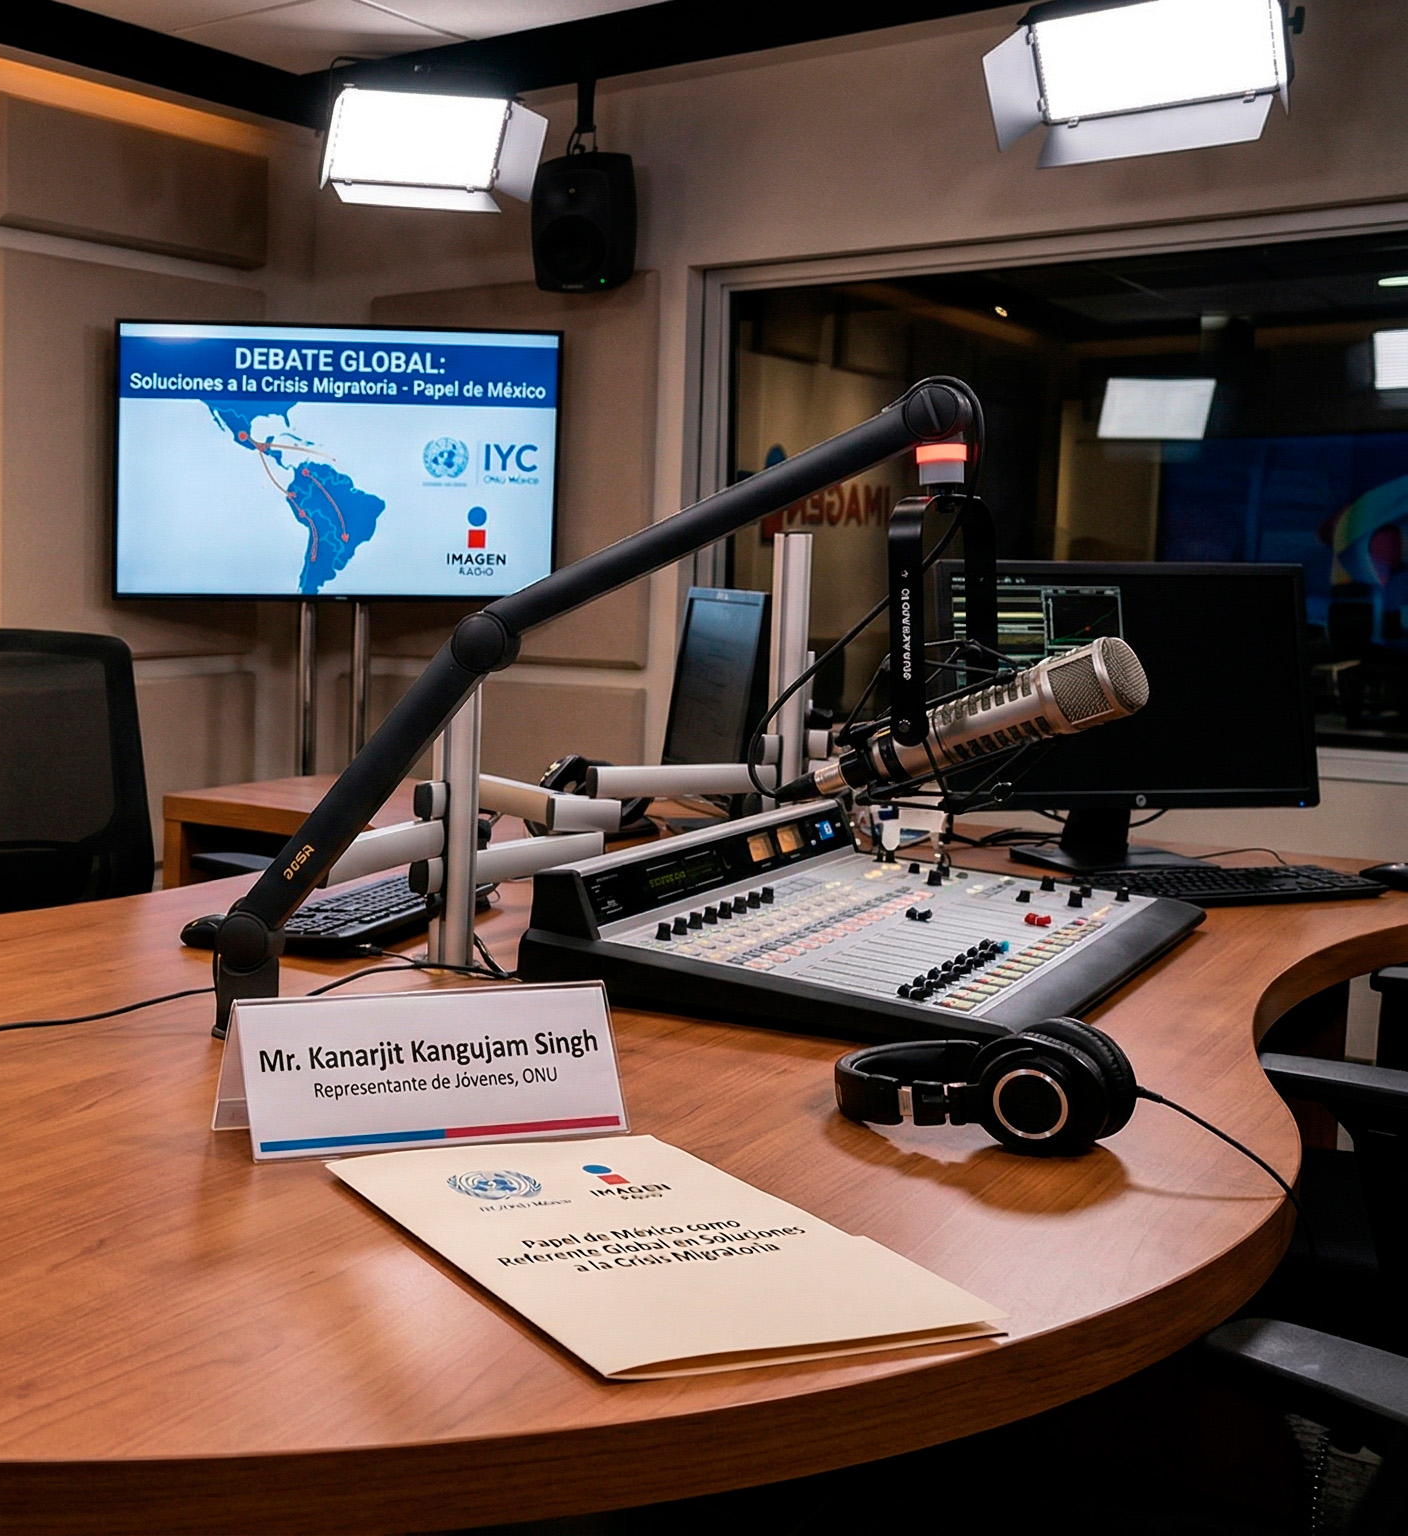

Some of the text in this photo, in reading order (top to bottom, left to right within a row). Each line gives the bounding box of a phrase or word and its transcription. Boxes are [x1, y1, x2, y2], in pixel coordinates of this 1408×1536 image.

[235, 347, 446, 375] DEBATE GLOBAL:
[130, 372, 224, 390] Soluciones
[227, 379, 238, 391] a
[242, 375, 257, 392] la
[261, 376, 309, 393] Crisis
[313, 377, 398, 398] Migratoria
[413, 380, 460, 400] Papel
[463, 380, 484, 398] de
[487, 381, 547, 400] México
[484, 444, 538, 472] IYC
[446, 553, 507, 566] IMAGEN
[259, 1029, 599, 1073] Mr. Kanarjit Kangujam Singh
[314, 1067, 558, 1101] Representante de Jóvenes, ONU
[497, 1226, 806, 1267] Referente Global en Soluciones
[522, 1233, 581, 1249] Papel
[583, 1232, 611, 1244] de
[686, 1220, 741, 1232] como
[573, 1264, 590, 1273] a
[588, 1260, 613, 1271] la
[614, 1255, 672, 1268] Crisis
